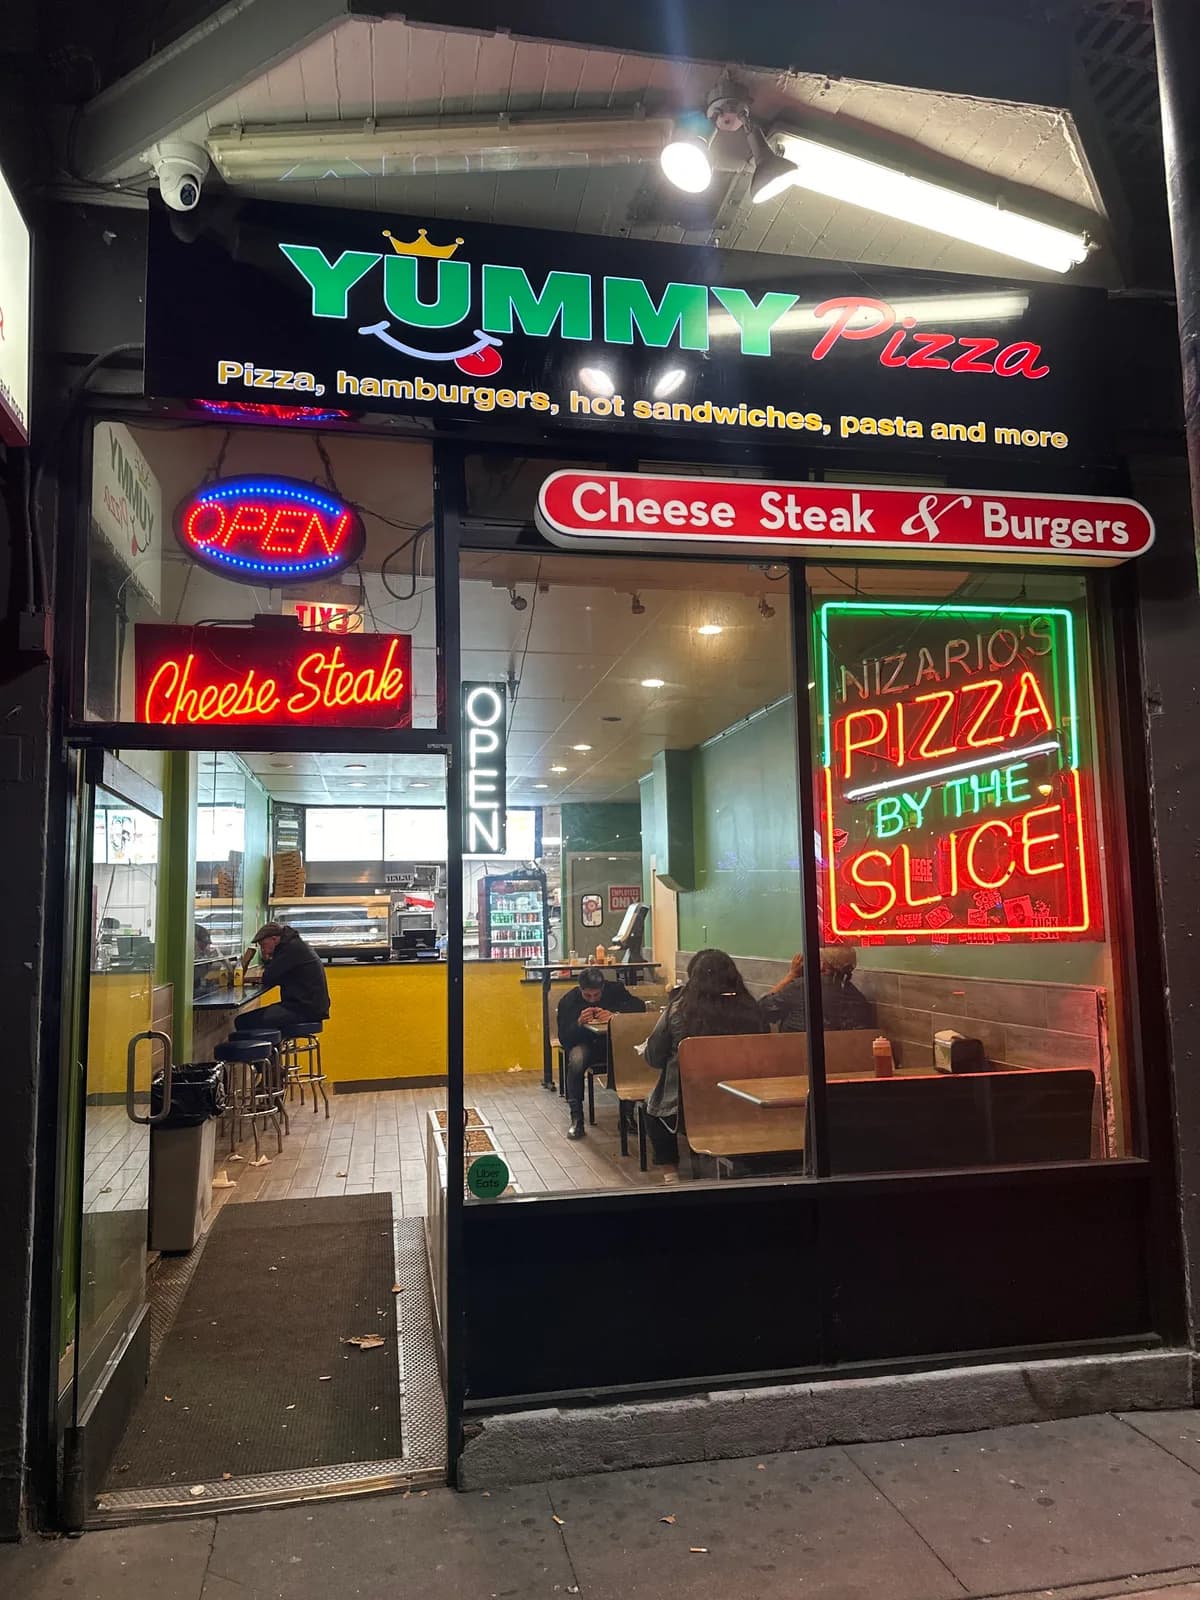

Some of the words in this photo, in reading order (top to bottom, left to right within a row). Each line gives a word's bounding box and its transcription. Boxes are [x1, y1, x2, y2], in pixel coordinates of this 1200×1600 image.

[279, 243, 801, 358] YUMMY
[810, 296, 1051, 379] Pizza
[217, 360, 325, 396] Pizza,
[337, 370, 560, 415] hamburgers,
[570, 390, 626, 419] hot
[633, 396, 832, 436] sandwiches,
[840, 413, 925, 441] pasta
[931, 418, 987, 444] and
[994, 427, 1069, 449] more
[186, 500, 349, 557] OPEN
[571, 481, 736, 528] Cheese
[759, 491, 875, 535] Steak
[901, 494, 973, 541] &
[983, 501, 1130, 549] Burgers
[146, 654, 280, 725] Cheese
[287, 637, 404, 713] Steak
[841, 615, 1054, 702] NIZARIO'S
[844, 671, 1054, 779] PIZZA
[466, 686, 503, 854] OPEN
[876, 786, 933, 839] BY
[946, 762, 1032, 818] THE
[850, 804, 1066, 920] SLICE
[475, 1168, 500, 1179] Uber
[475, 1179, 500, 1188] Eats
